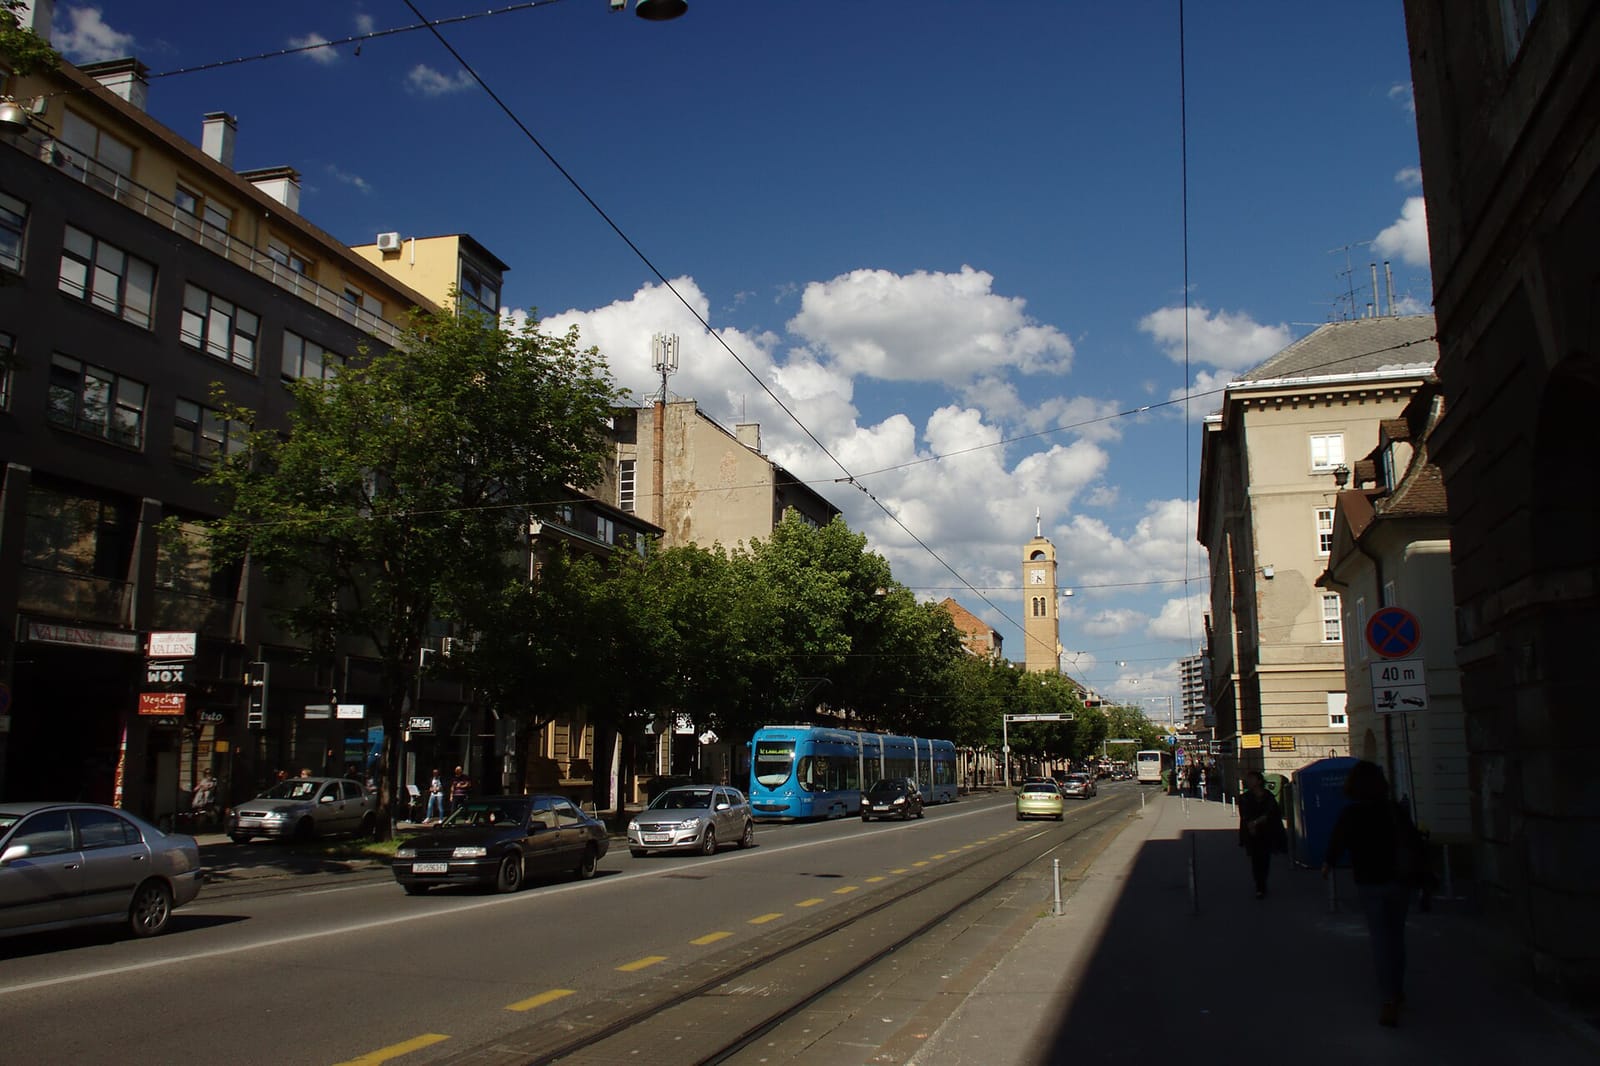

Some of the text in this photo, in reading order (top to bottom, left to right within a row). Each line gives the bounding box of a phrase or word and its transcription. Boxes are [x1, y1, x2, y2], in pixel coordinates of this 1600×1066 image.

[33, 623, 96, 643] VALENS
[151, 643, 194, 655] VALENS
[147, 671, 183, 683] WOX
[1382, 666, 1416, 681] 40 m
